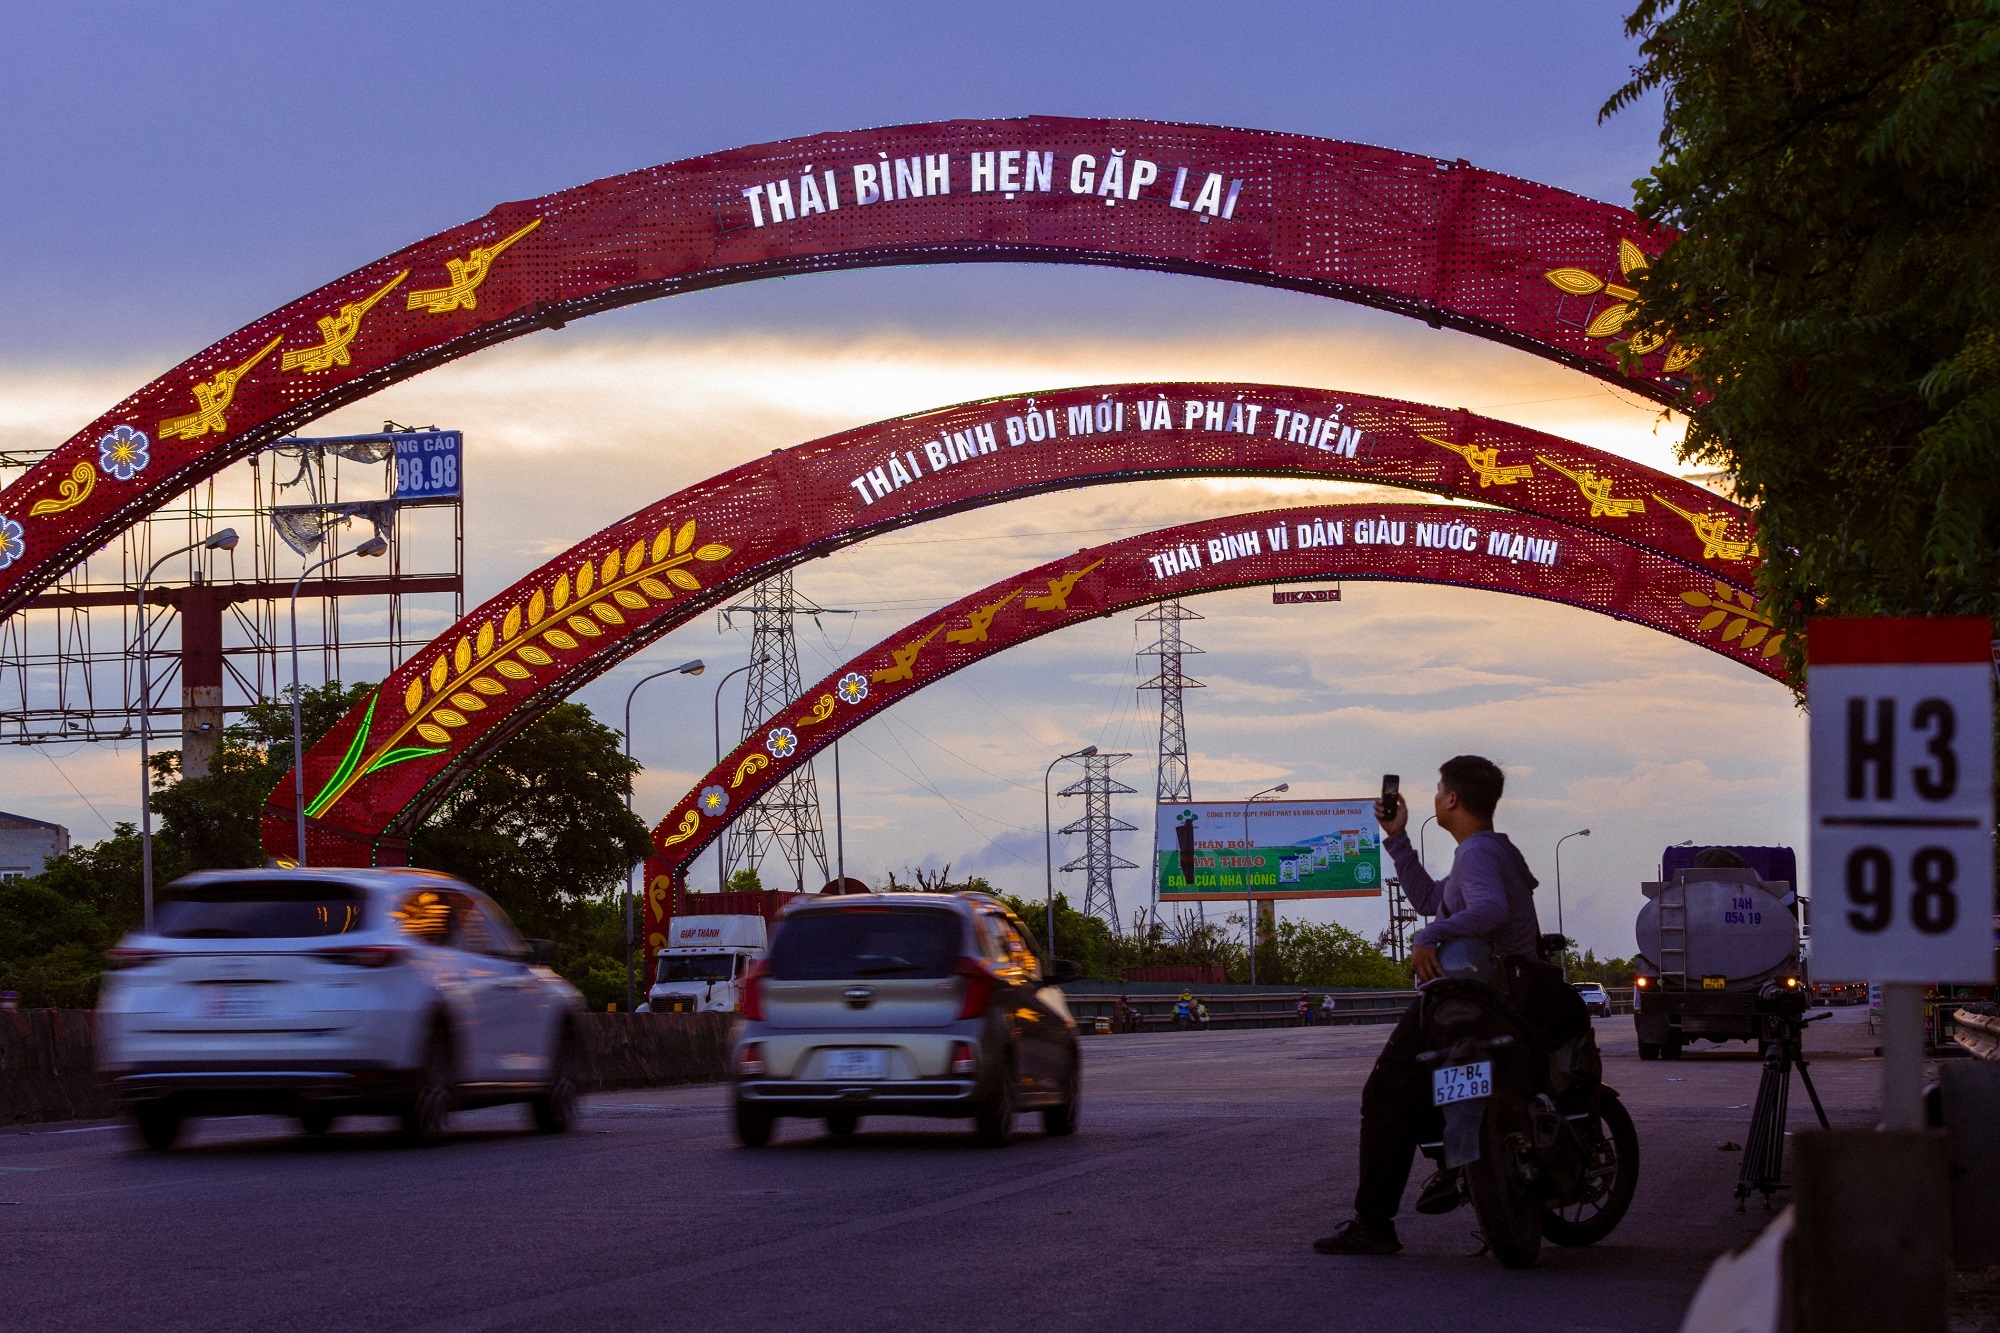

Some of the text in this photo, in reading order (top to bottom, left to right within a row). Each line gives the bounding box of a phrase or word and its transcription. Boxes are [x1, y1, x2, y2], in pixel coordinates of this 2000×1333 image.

[742, 147, 1243, 228] THÁI BÌNH HẸN GẶP LẠI
[423, 435, 455, 452] CÁO
[850, 394, 1363, 506] THÁI BÌNH ĐỔI MỚI VÀ PHÁT TRIỂN
[1149, 514, 1560, 579] THÁI BÌNH VÌ DÂN GIÀU NƯỚC MẠNH
[1273, 589, 1342, 604] MIKADO
[1846, 697, 1958, 801] H3
[1194, 871, 1217, 886] CỦA
[1219, 872, 1243, 886] NHÀ
[1846, 846, 1958, 935] 98
[1732, 897, 1753, 910] 14H
[1443, 1064, 1483, 1085] 17-B4
[1436, 1080, 1490, 1103] 522.88
